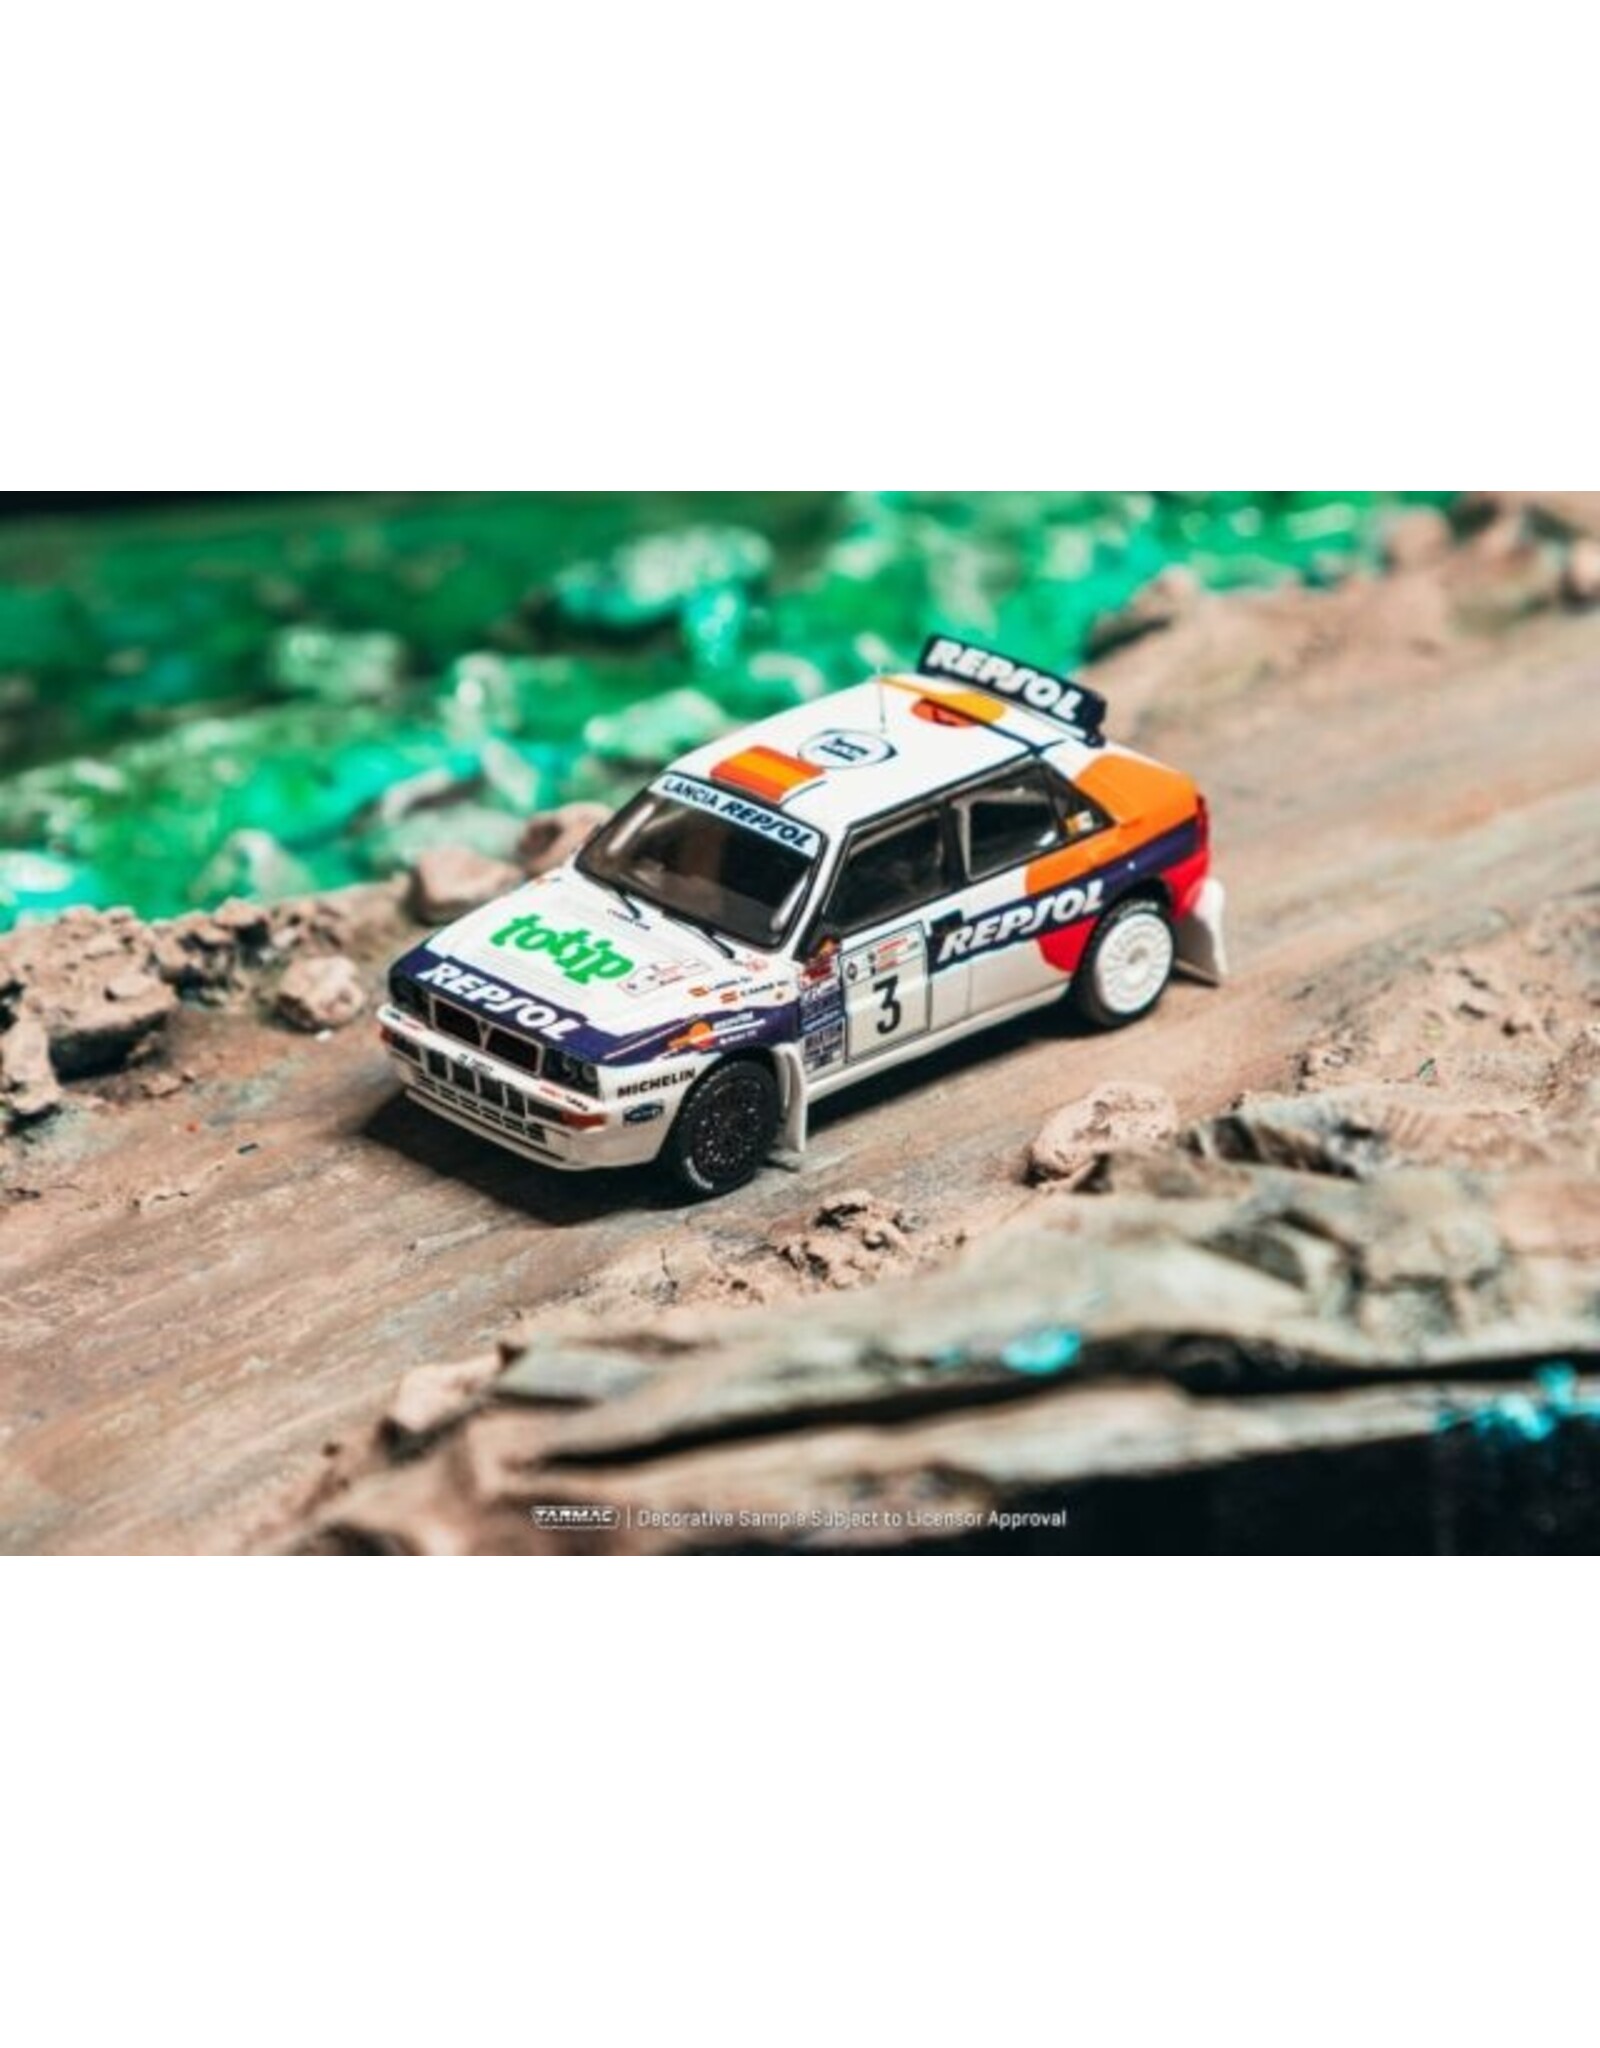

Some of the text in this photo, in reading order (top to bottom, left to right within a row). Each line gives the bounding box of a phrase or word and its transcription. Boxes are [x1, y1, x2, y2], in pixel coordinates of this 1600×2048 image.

[925, 639, 1083, 721] REPSOL
[663, 779, 814, 848] LANCIA REPSOL
[489, 914, 634, 984] totip
[937, 878, 1104, 964] REPSOL
[415, 962, 581, 1041] REPSOL
[873, 974, 902, 1035] 3
[617, 1067, 696, 1098] MICHELIN
